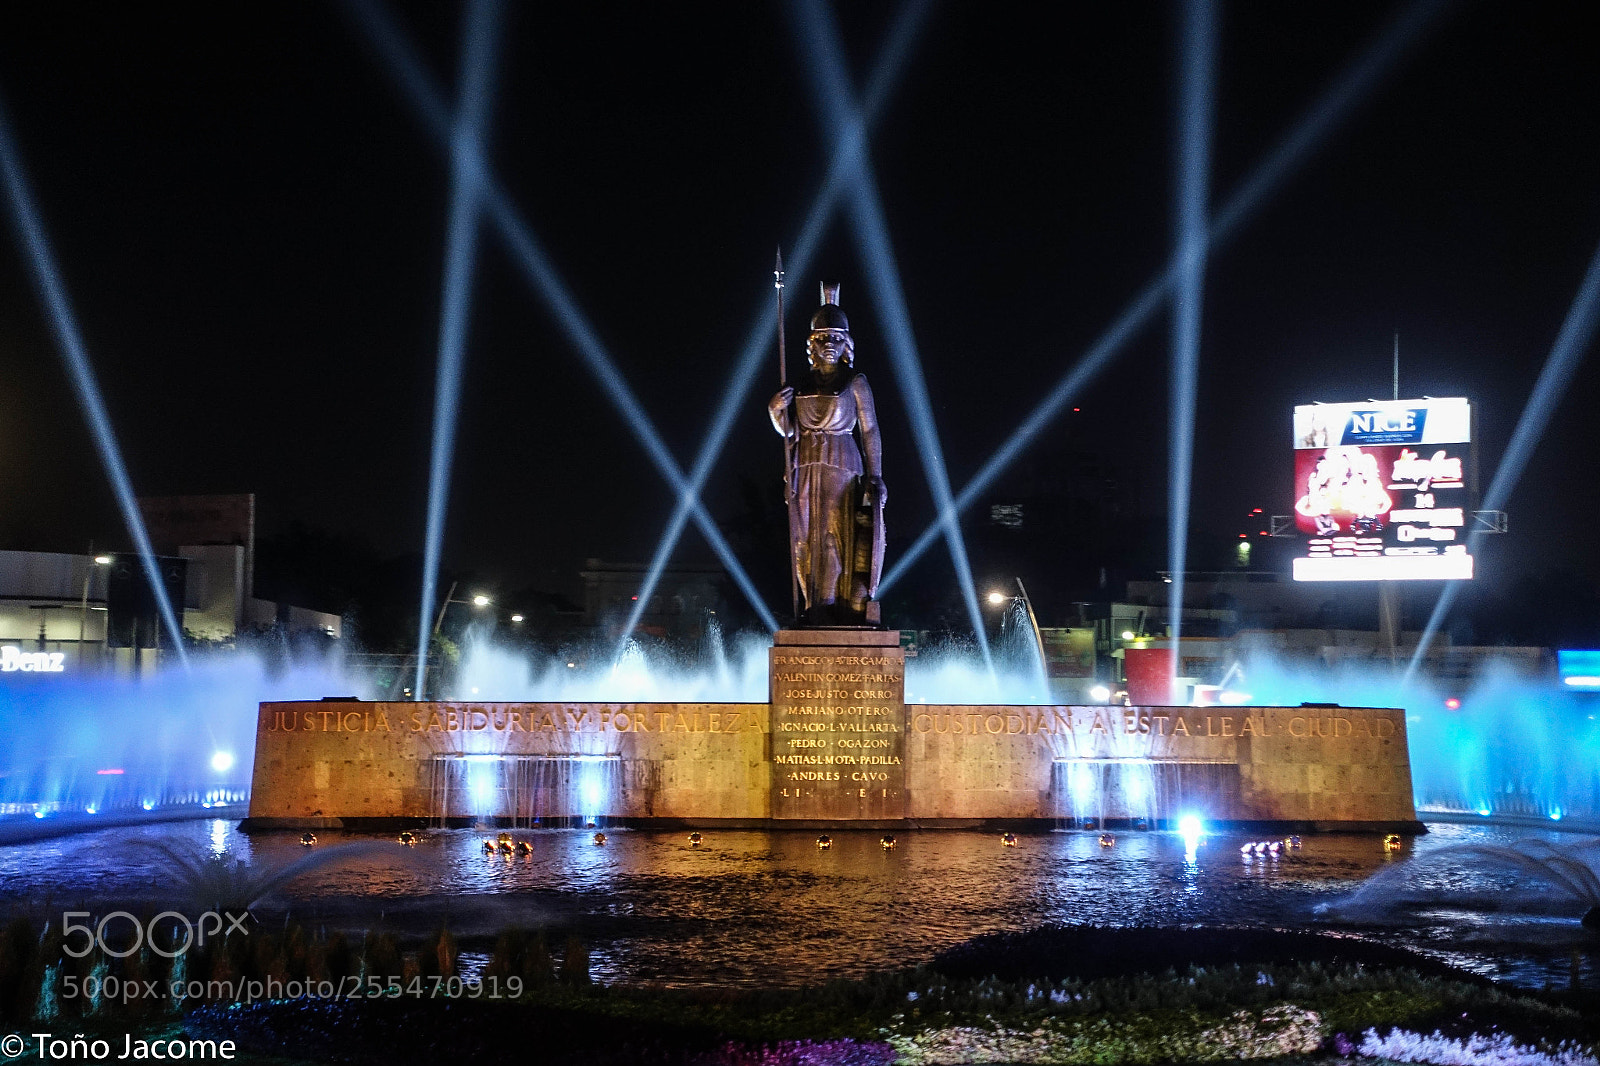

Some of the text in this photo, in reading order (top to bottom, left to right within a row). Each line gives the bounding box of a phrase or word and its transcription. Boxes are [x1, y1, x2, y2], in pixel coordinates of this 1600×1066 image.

[777, 673, 899, 683] VALENTIN GOMEZ FARIAS
[785, 690, 893, 699] JOSE JUSTO CORRO
[788, 706, 890, 716] MARIANO OTERO
[267, 711, 764, 734] JUSTICIA SABIDURIA Y FORTALEZA
[781, 722, 898, 733] IGNACIO L VALLARTA
[912, 713, 1396, 738] CUSTODIAN A ESTA LEAL CIUDAD
[790, 739, 888, 749] PEDRO OGAZON
[775, 755, 816, 765] MATIAS
[824, 755, 855, 765] MOTA
[859, 755, 901, 765] PADILLA
[790, 772, 888, 781] ANDRES CAVO
